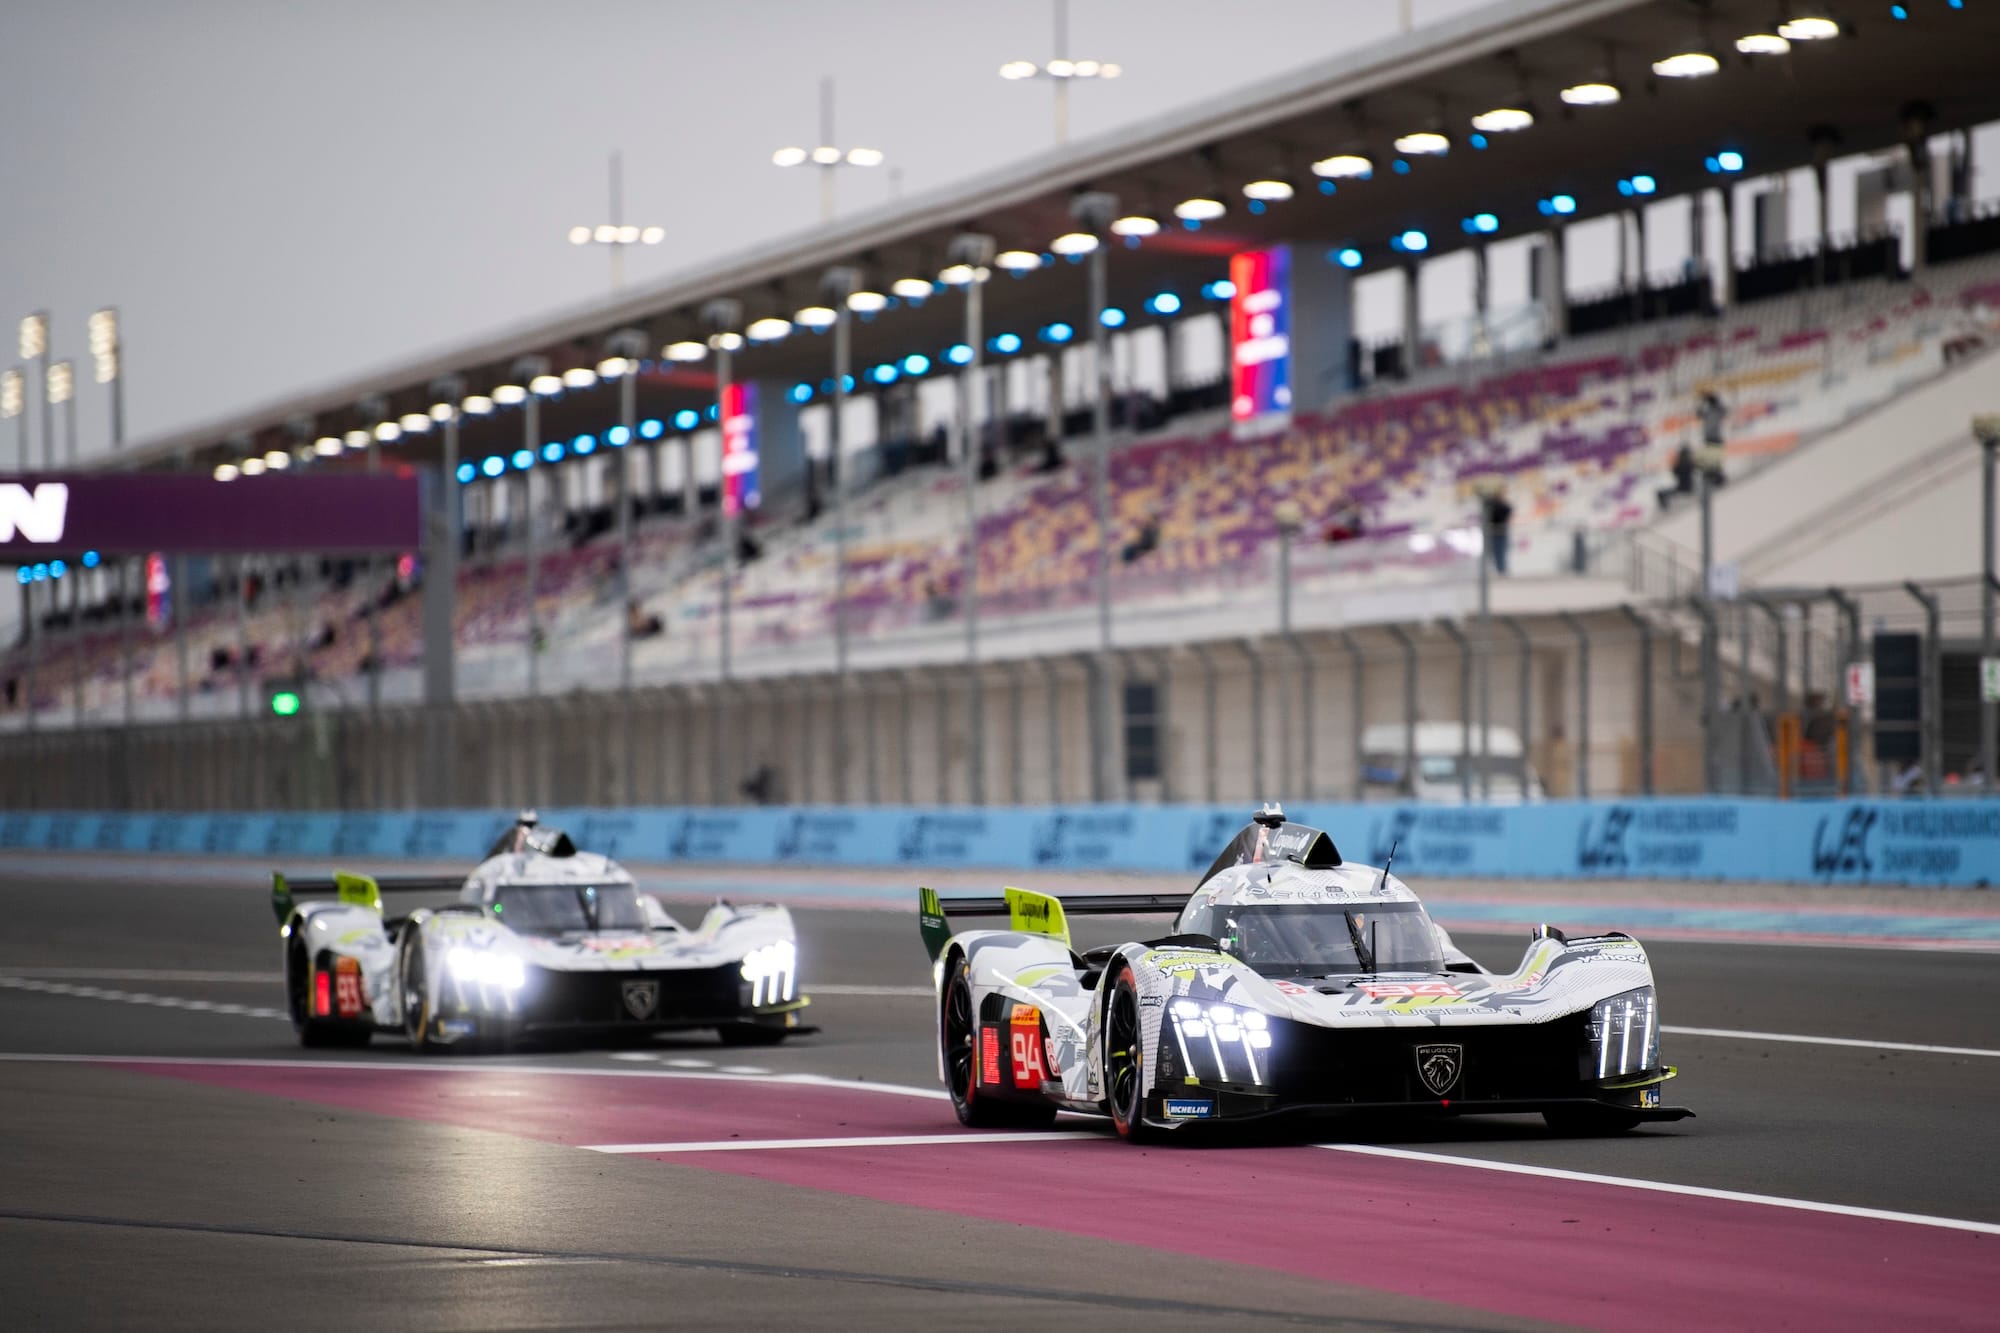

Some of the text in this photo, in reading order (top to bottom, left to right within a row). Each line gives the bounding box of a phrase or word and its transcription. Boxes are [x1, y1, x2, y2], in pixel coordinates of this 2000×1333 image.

[1577, 953, 1646, 964] yahoo!
[1160, 962, 1232, 978] yahoo!
[337, 975, 362, 1012] 93
[1365, 984, 1457, 997] 94
[1012, 1033, 1046, 1081] 94
[1170, 1105, 1209, 1114] MICHELIN
